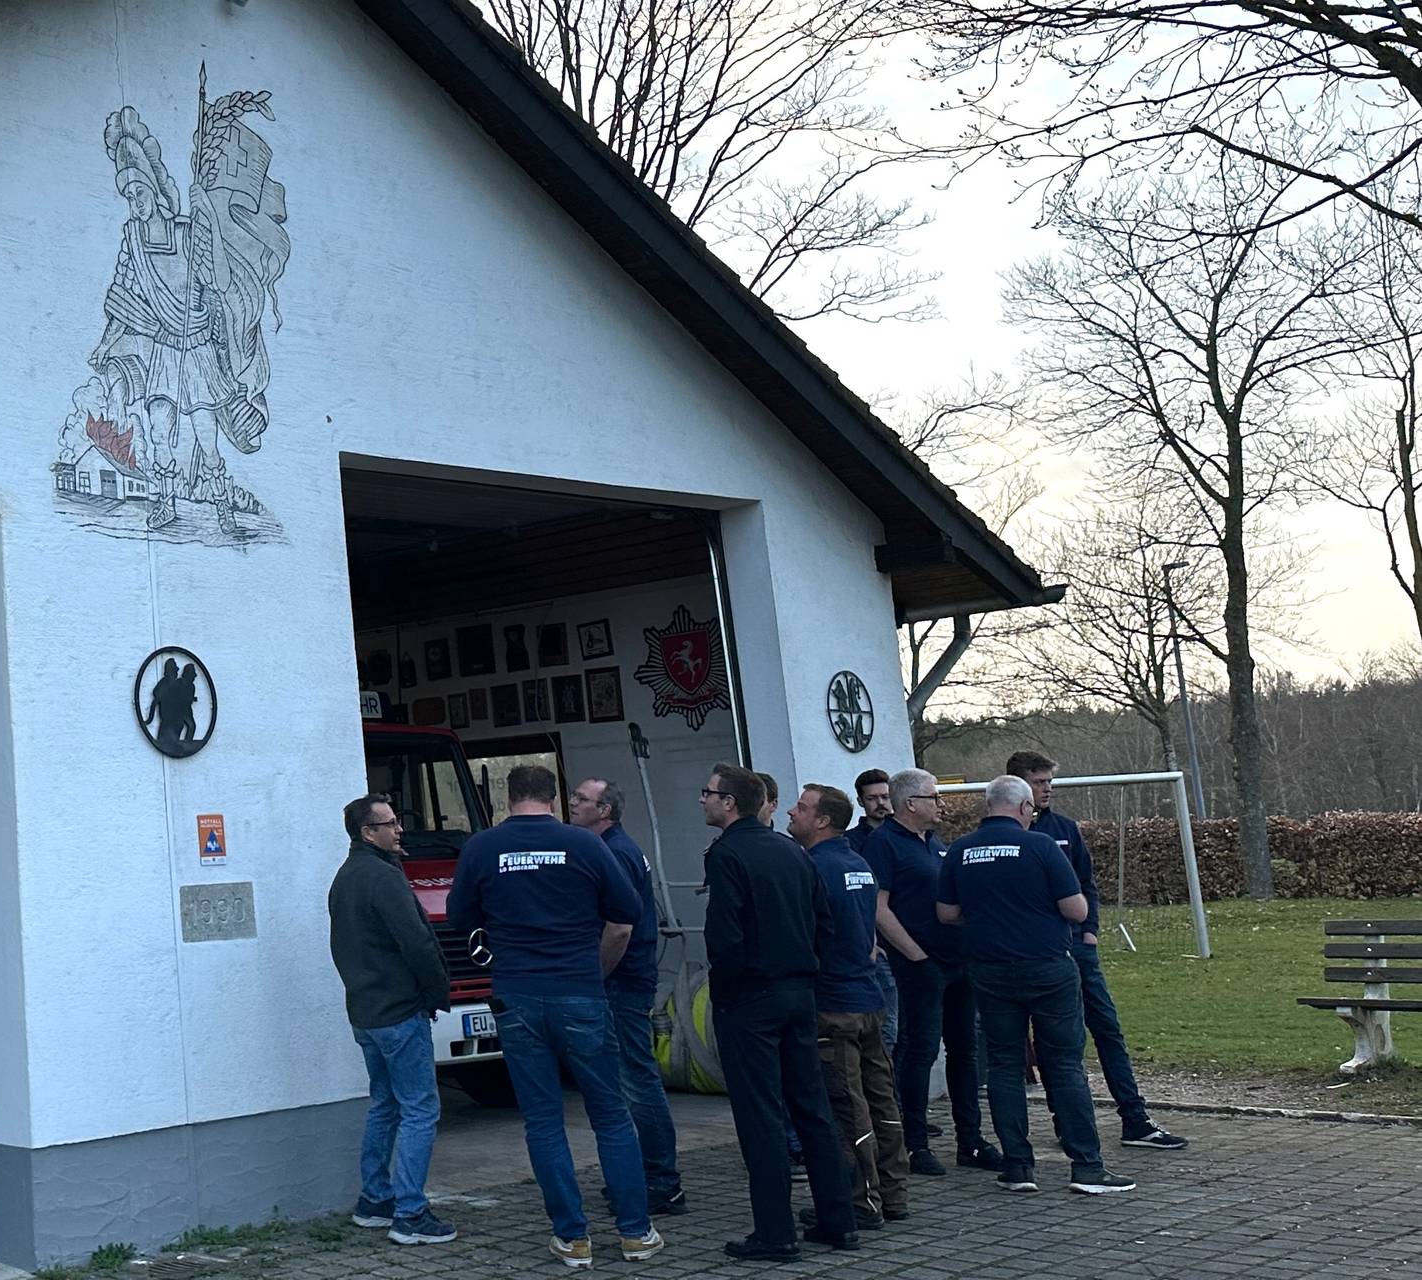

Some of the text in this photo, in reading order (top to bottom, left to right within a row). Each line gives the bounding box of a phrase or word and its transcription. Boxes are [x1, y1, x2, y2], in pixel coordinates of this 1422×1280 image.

[499, 853, 566, 867] FEUERWEHR
[963, 848, 1020, 860] FEUERWEHR
[473, 1015, 488, 1032] EU
